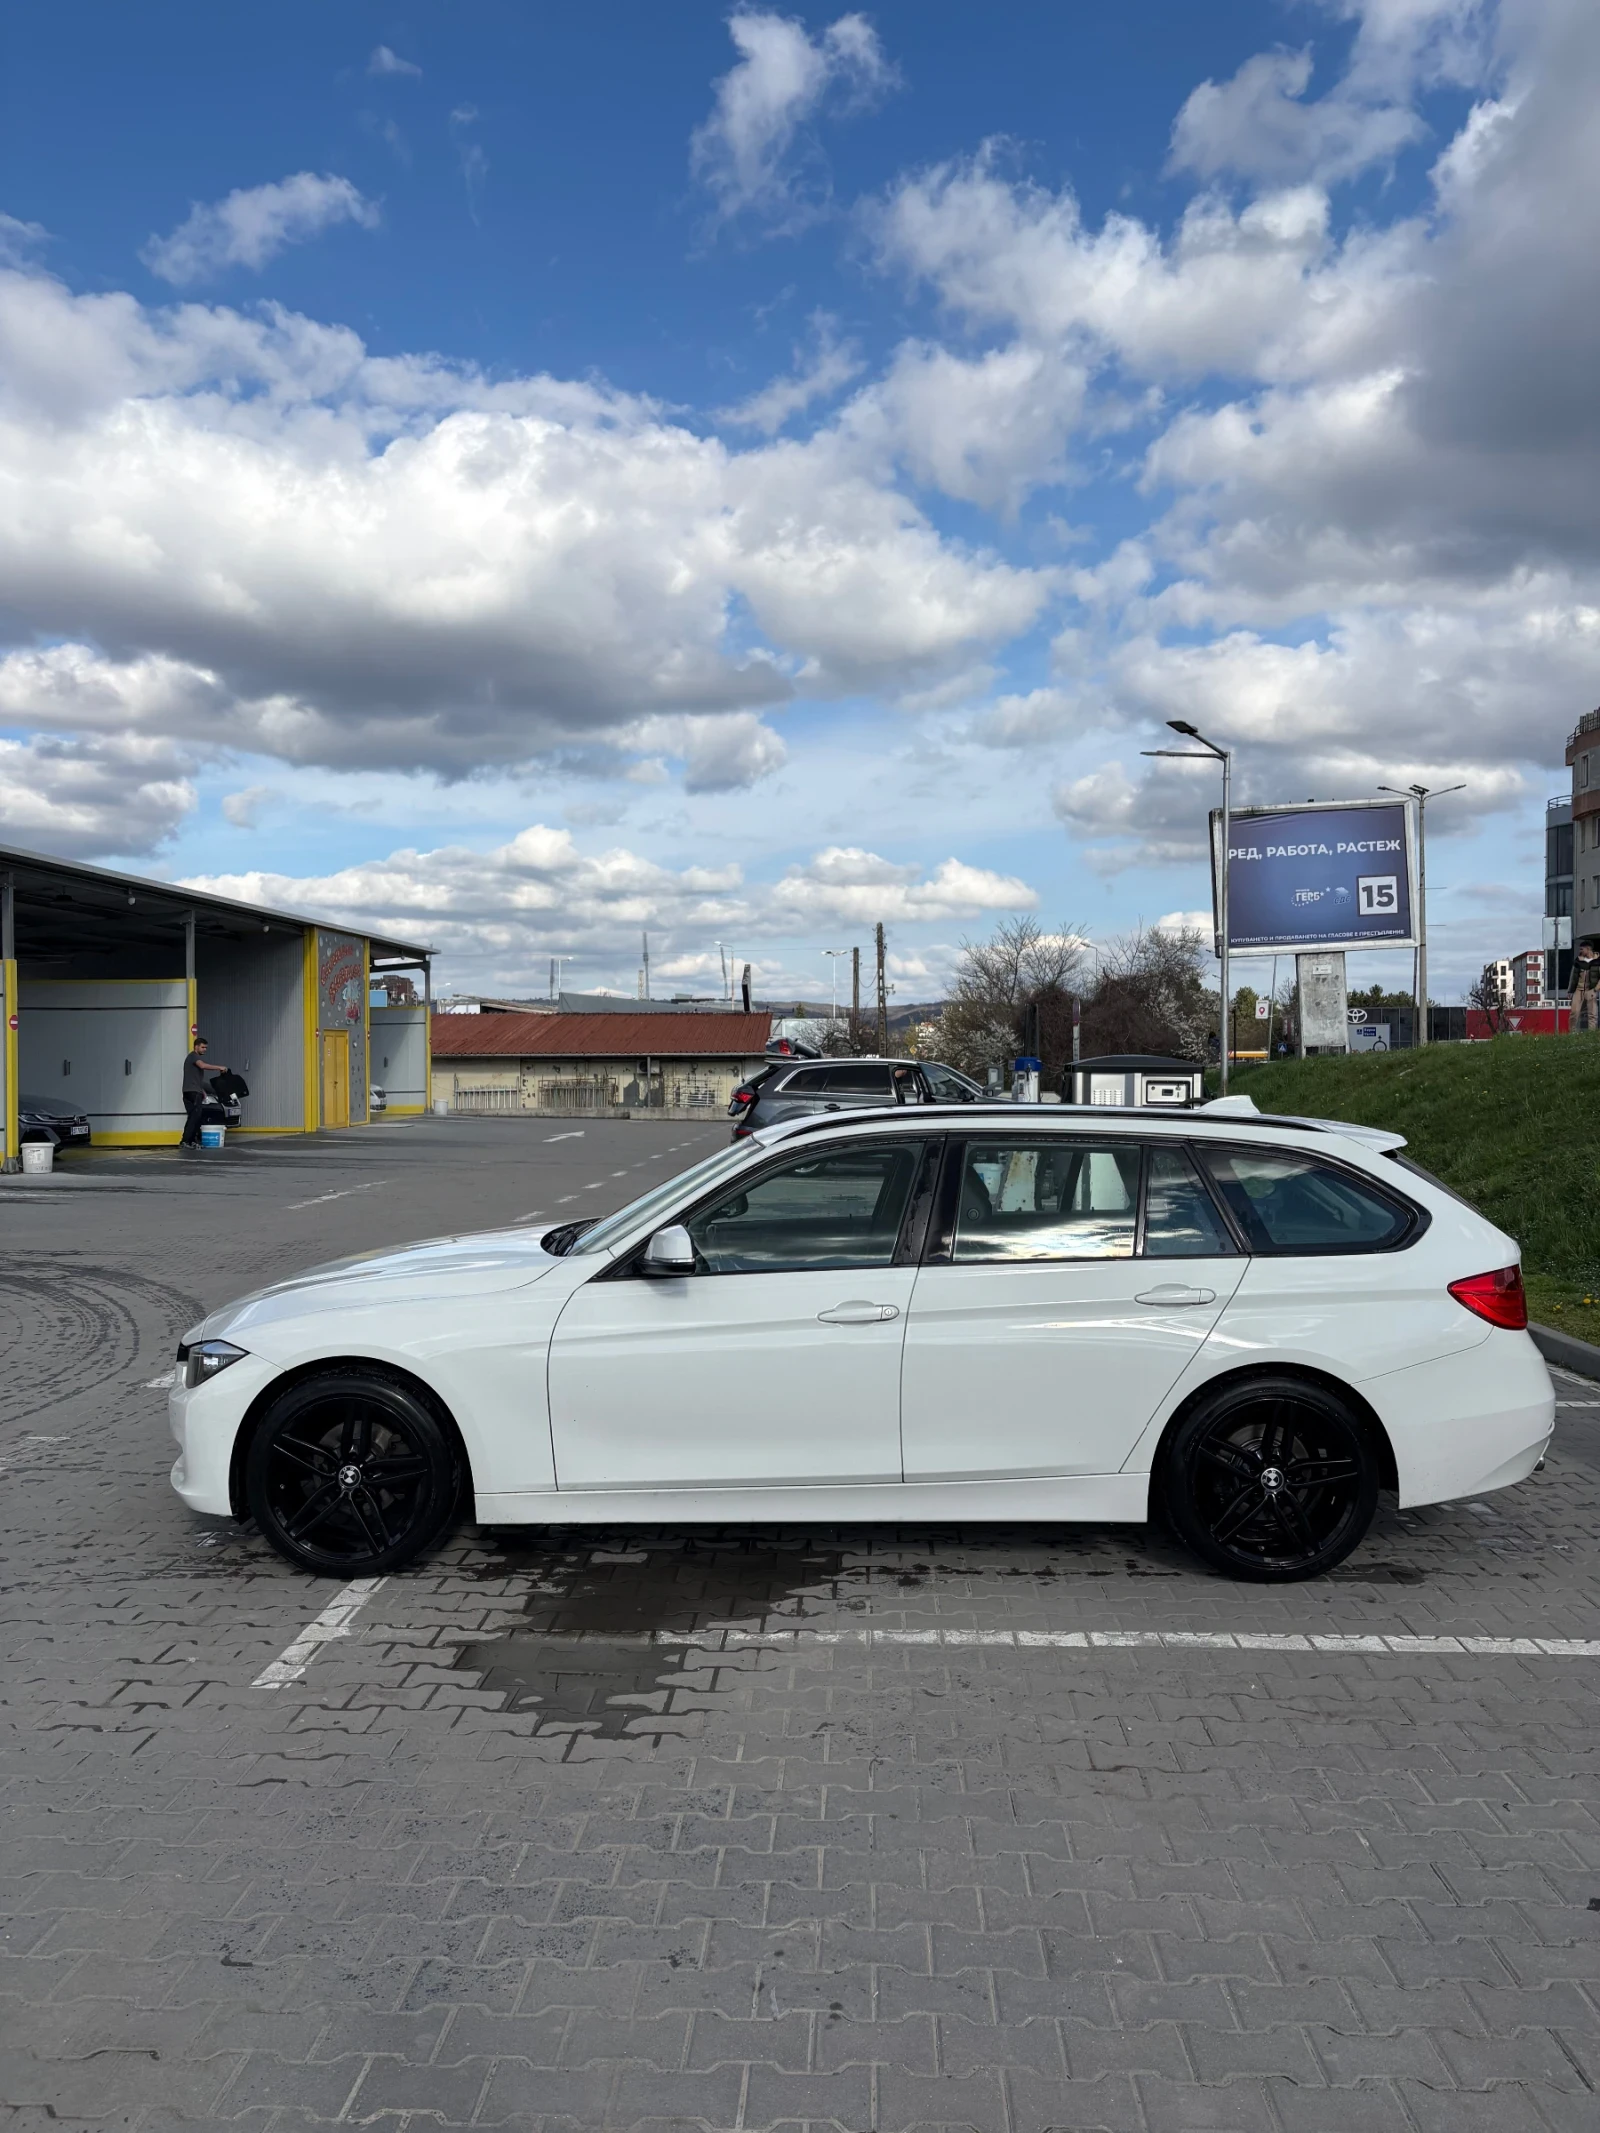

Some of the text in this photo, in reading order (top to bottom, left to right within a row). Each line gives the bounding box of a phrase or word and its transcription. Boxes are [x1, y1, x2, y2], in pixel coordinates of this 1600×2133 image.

[1228, 840, 1401, 860] РЕД, РАБОТА, РАСТЕЖ
[1296, 891, 1320, 902] ГЕРБ
[1361, 884, 1395, 908] 15
